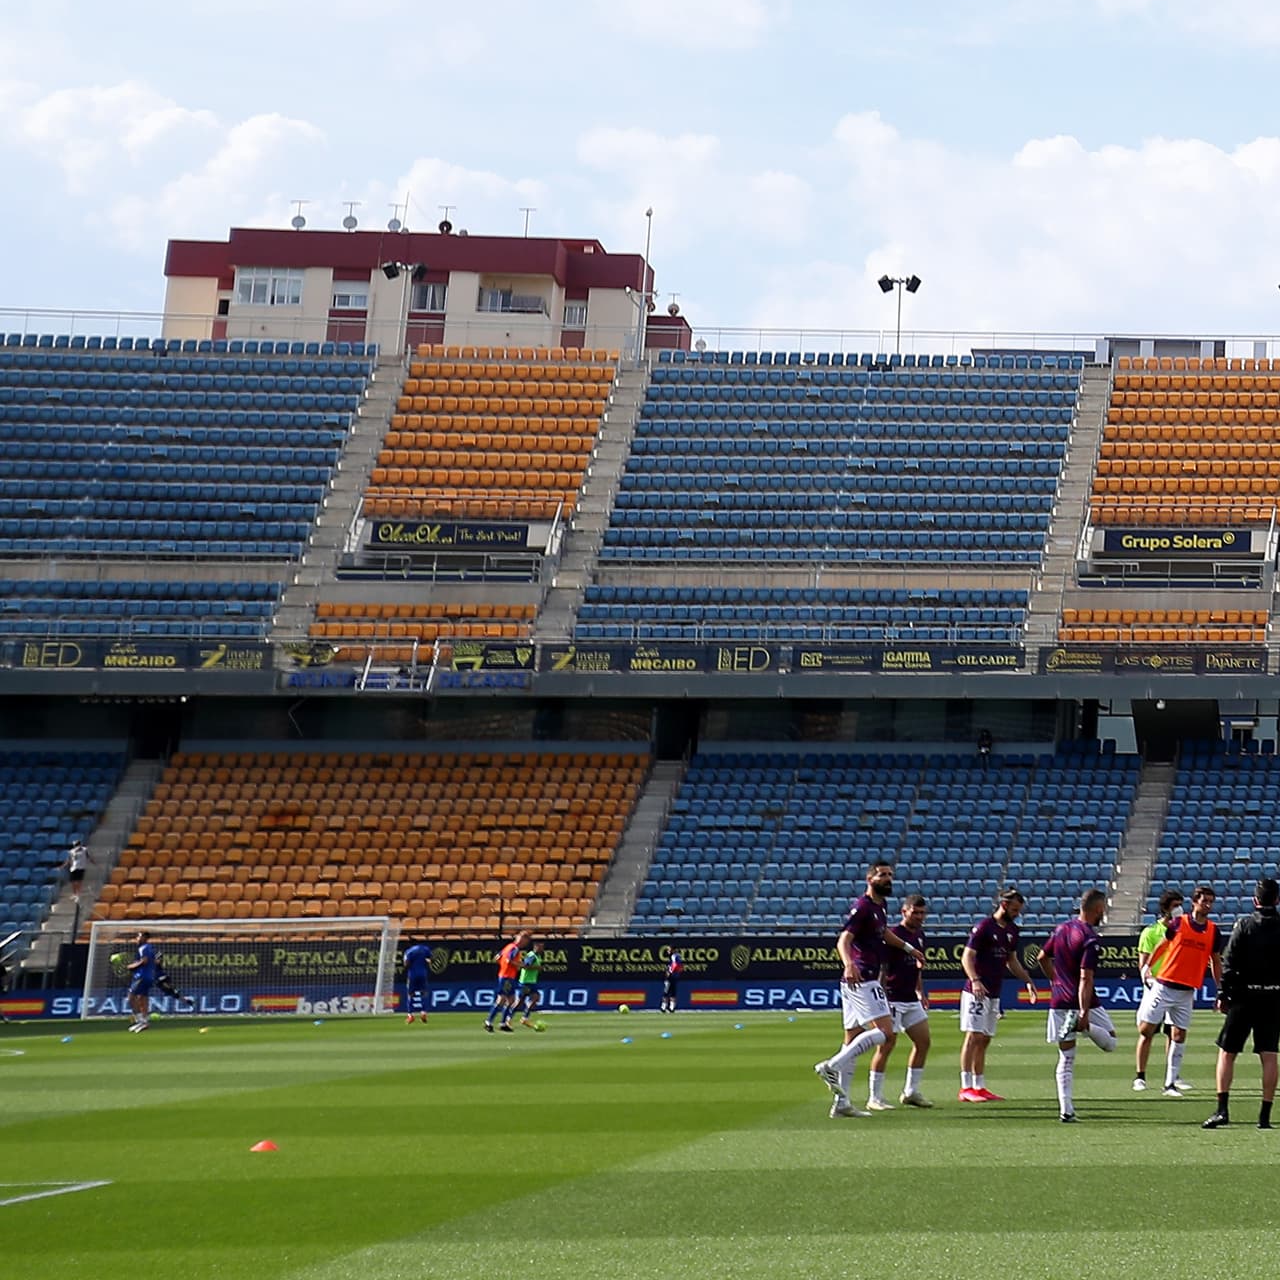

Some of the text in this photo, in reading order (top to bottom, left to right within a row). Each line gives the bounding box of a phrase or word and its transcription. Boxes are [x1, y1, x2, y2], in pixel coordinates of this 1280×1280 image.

[1122, 533, 1223, 551] Grupo Solera
[957, 655, 978, 666] GIL
[1115, 656, 1139, 666] LAS
[162, 953, 258, 966] MADRABA
[273, 948, 402, 965] PETACA CHIC
[450, 950, 567, 964] ALMBA
[581, 945, 652, 962] PETACA
[750, 947, 841, 961] ALMADRA
[744, 989, 842, 1006] SPAGN
[296, 996, 386, 1015] bet36
[968, 1002, 983, 1015] 22
